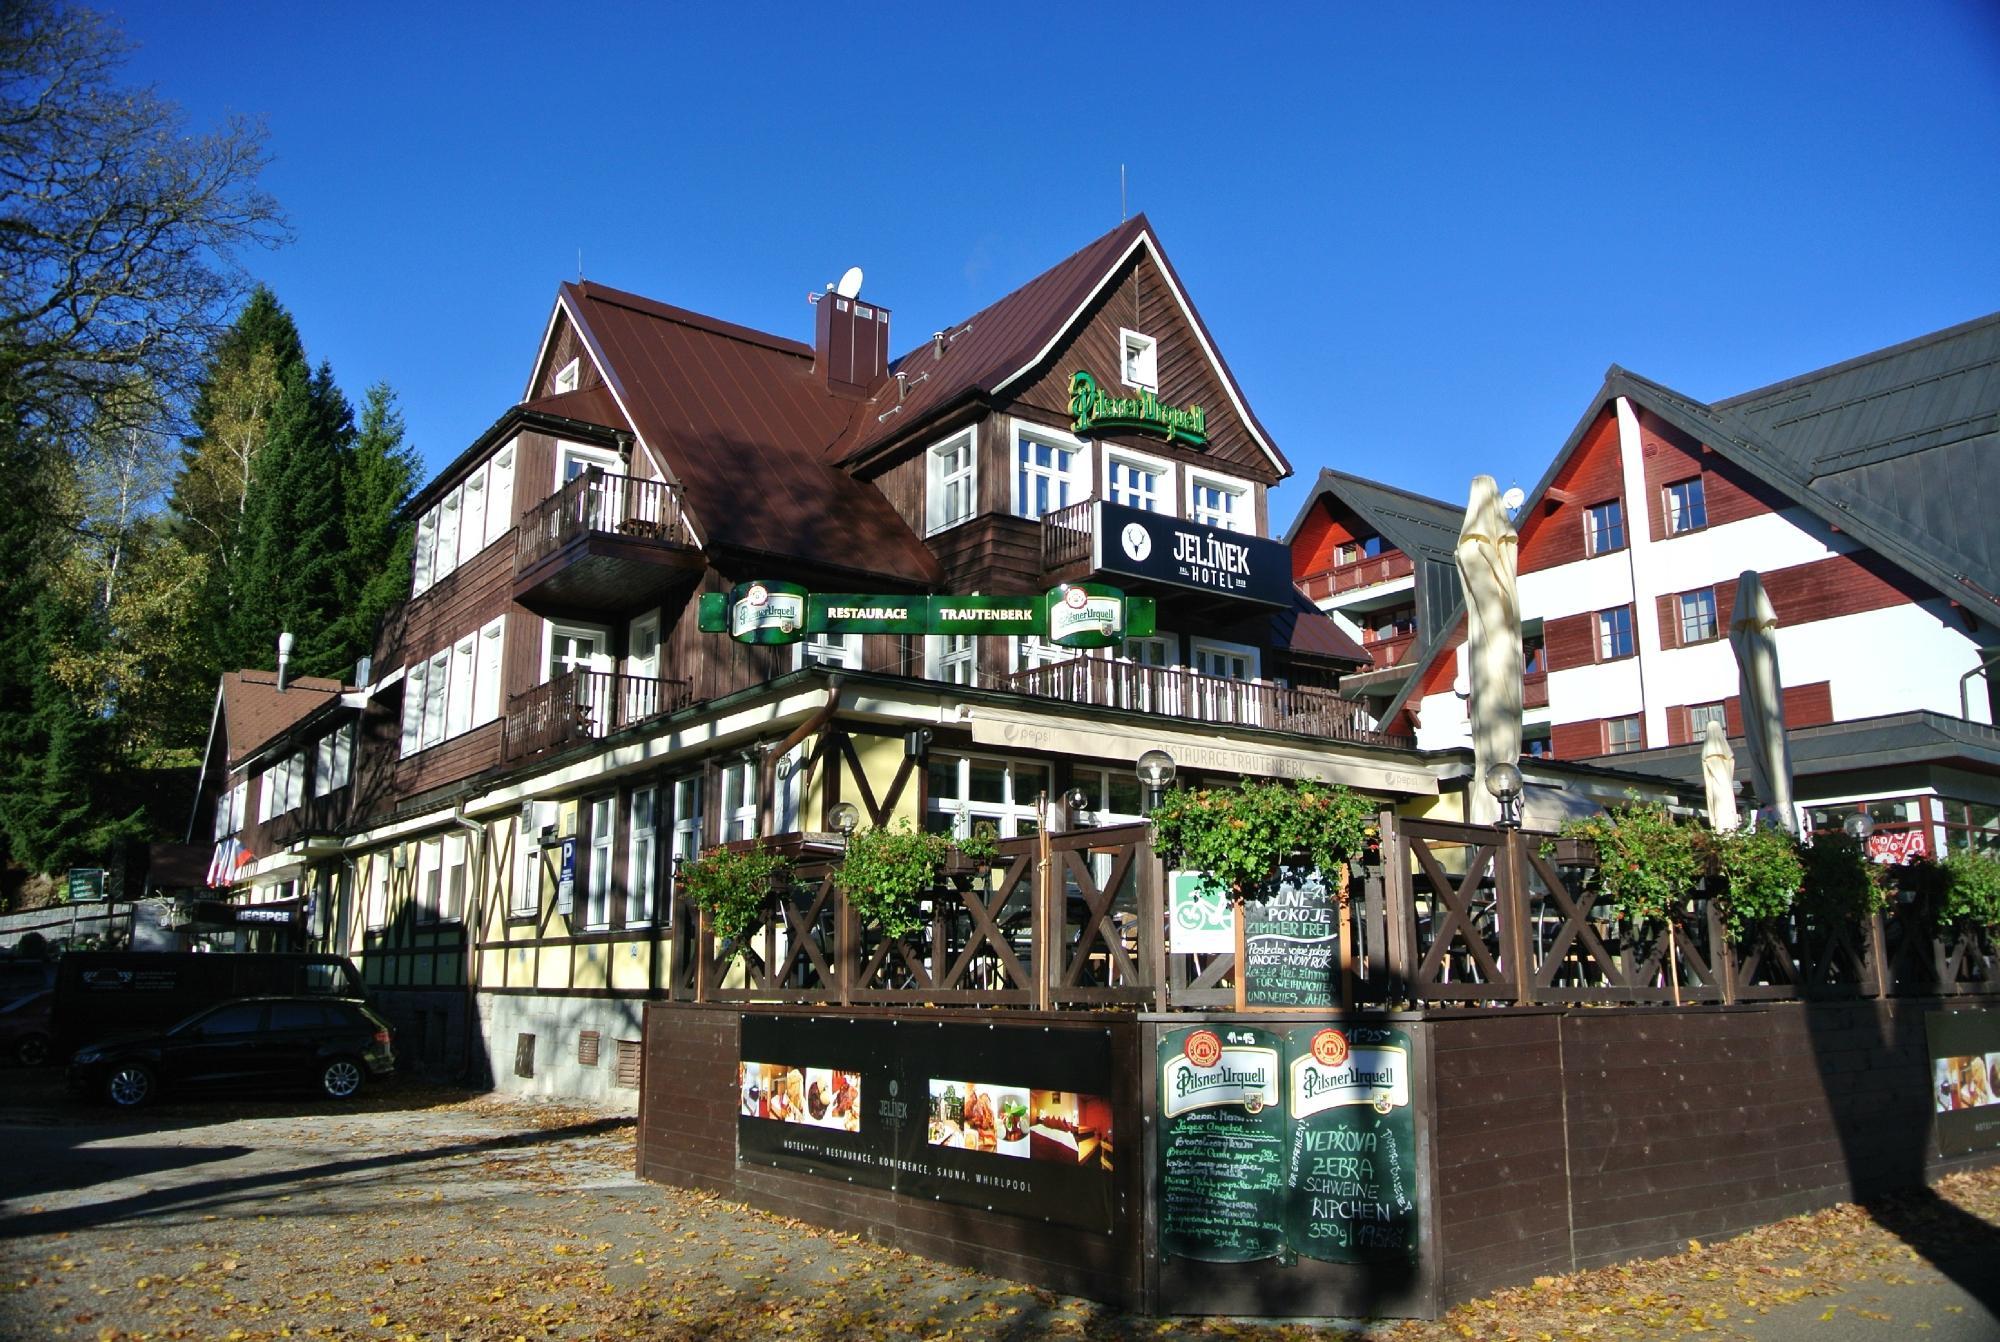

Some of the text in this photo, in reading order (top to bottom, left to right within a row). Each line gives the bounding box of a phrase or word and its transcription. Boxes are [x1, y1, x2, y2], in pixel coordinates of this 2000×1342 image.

[1068, 370, 1205, 441] Pilsner Urquell
[1173, 530, 1251, 575] JELÍNEK
[1191, 566, 1234, 589] HOTEL
[767, 603, 795, 620] Urquell
[827, 607, 908, 620] RESTAURACE
[939, 608, 1033, 621] TRAUTENBERK
[1086, 608, 1114, 622] Urquell
[1231, 752, 1306, 777] TRAUTENBERK
[563, 842, 573, 867] P
[236, 910, 290, 922] RECEPCE
[1268, 907, 1334, 924] POKOJE
[1246, 922, 1330, 937] ZIMMER FREI
[1248, 991, 1266, 1002] UND
[1176, 1066, 1265, 1098] Pilsner Urquell
[1303, 1066, 1393, 1099] Pilsner Urquell
[975, 1173, 1032, 1193] WHIRLPOOL
[1303, 1176, 1380, 1199] SCHWEINE
[1312, 1197, 1391, 1223] RIPCHEN
